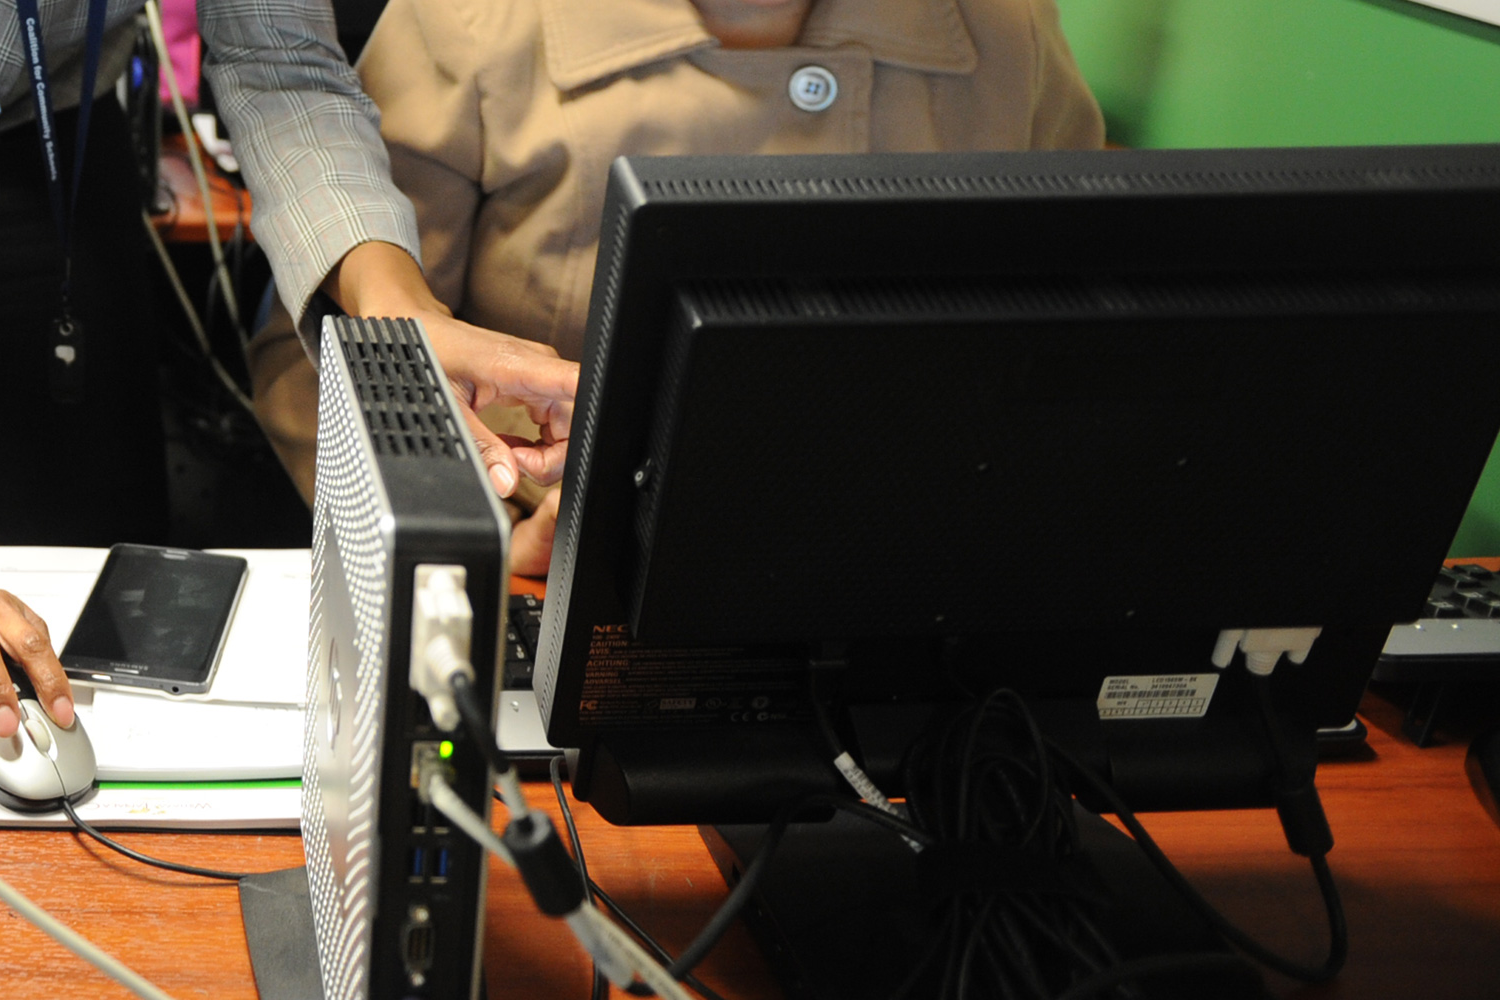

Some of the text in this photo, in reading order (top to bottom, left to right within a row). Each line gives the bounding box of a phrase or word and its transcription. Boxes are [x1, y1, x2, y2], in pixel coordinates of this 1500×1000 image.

[26, 17, 57, 182] Coalition for Community Schools
[593, 625, 629, 633] NEC
